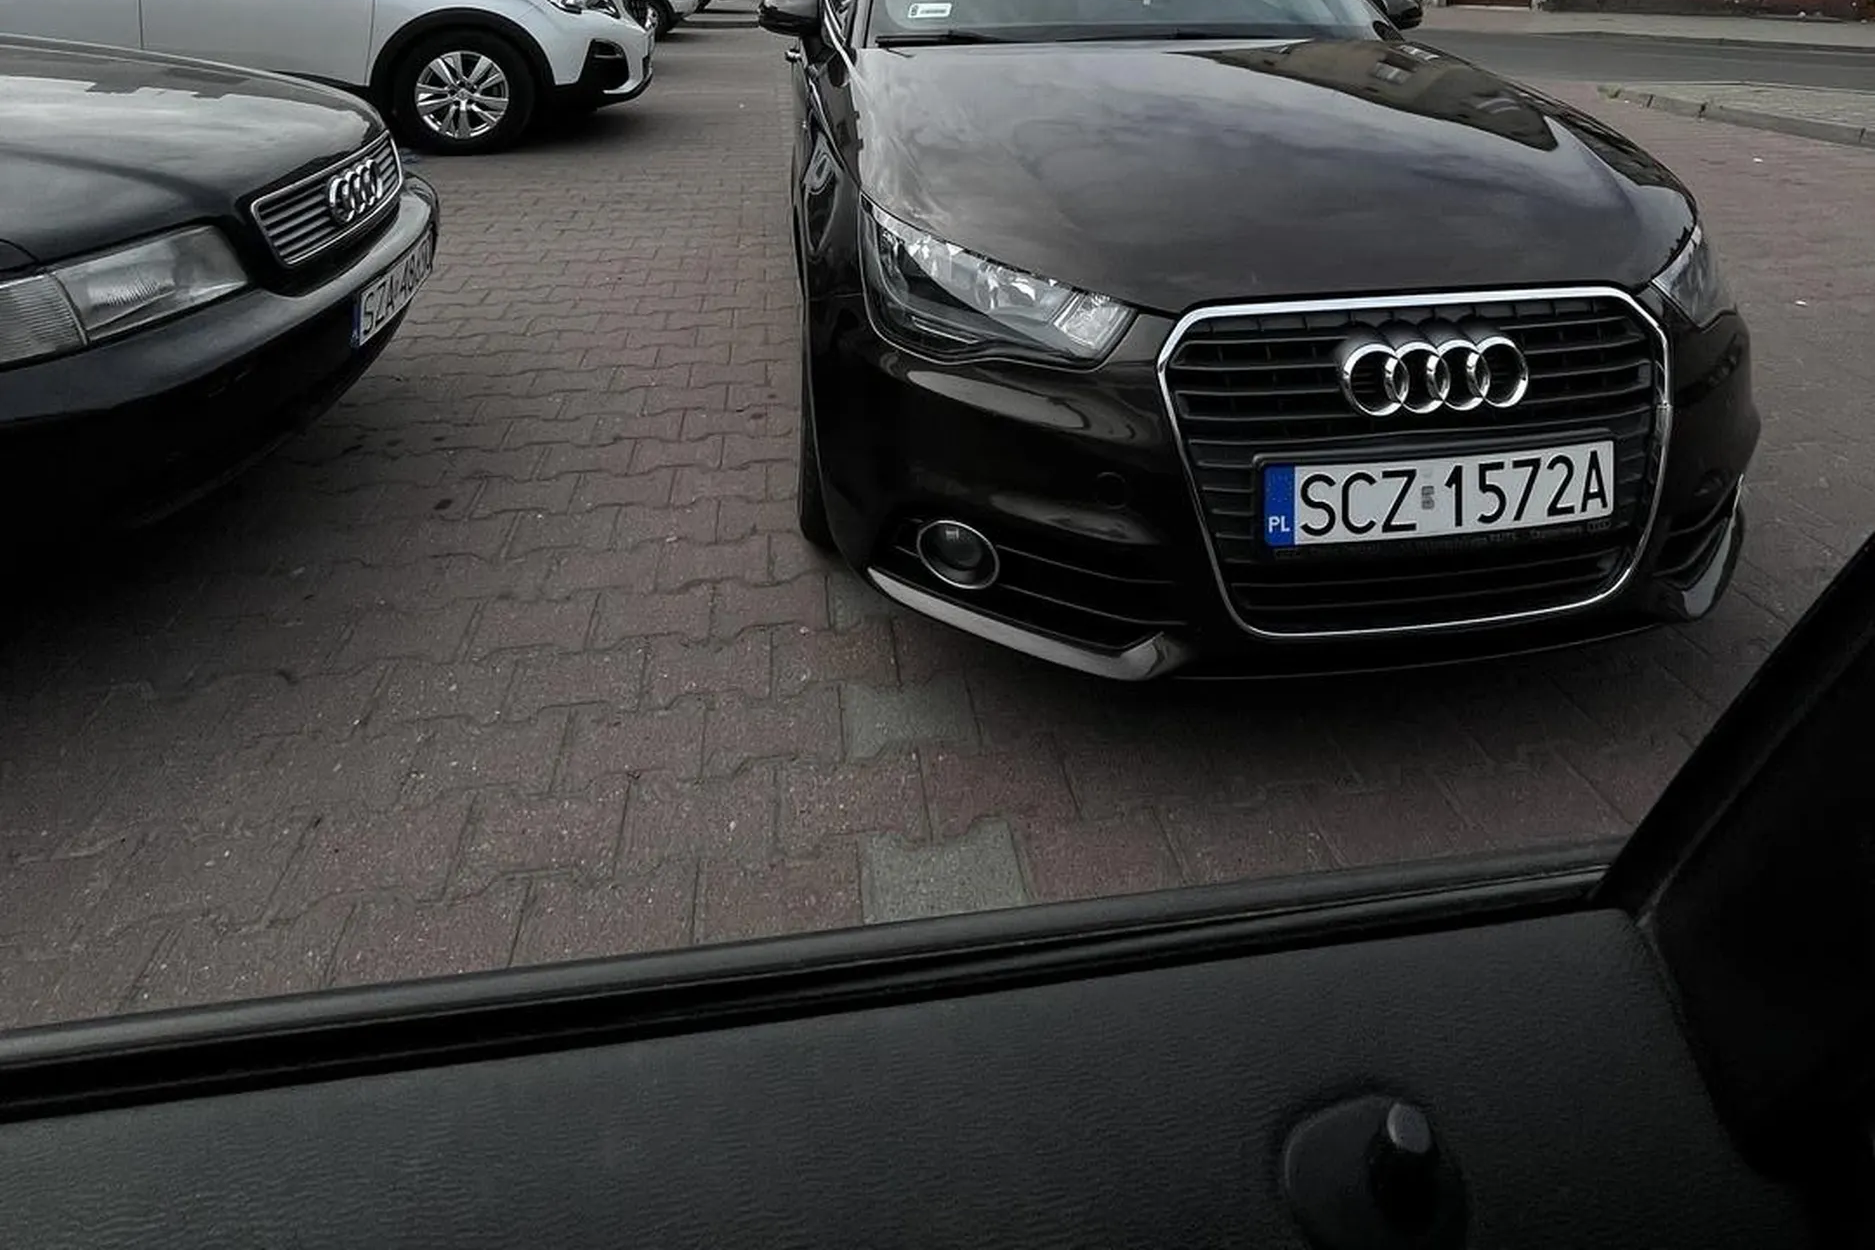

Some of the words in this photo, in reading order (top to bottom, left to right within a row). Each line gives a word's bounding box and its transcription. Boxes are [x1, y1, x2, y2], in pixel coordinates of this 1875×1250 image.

[1268, 515, 1291, 533] PL
[1299, 468, 1418, 537] SCZ
[1444, 449, 1609, 528] 1572A
